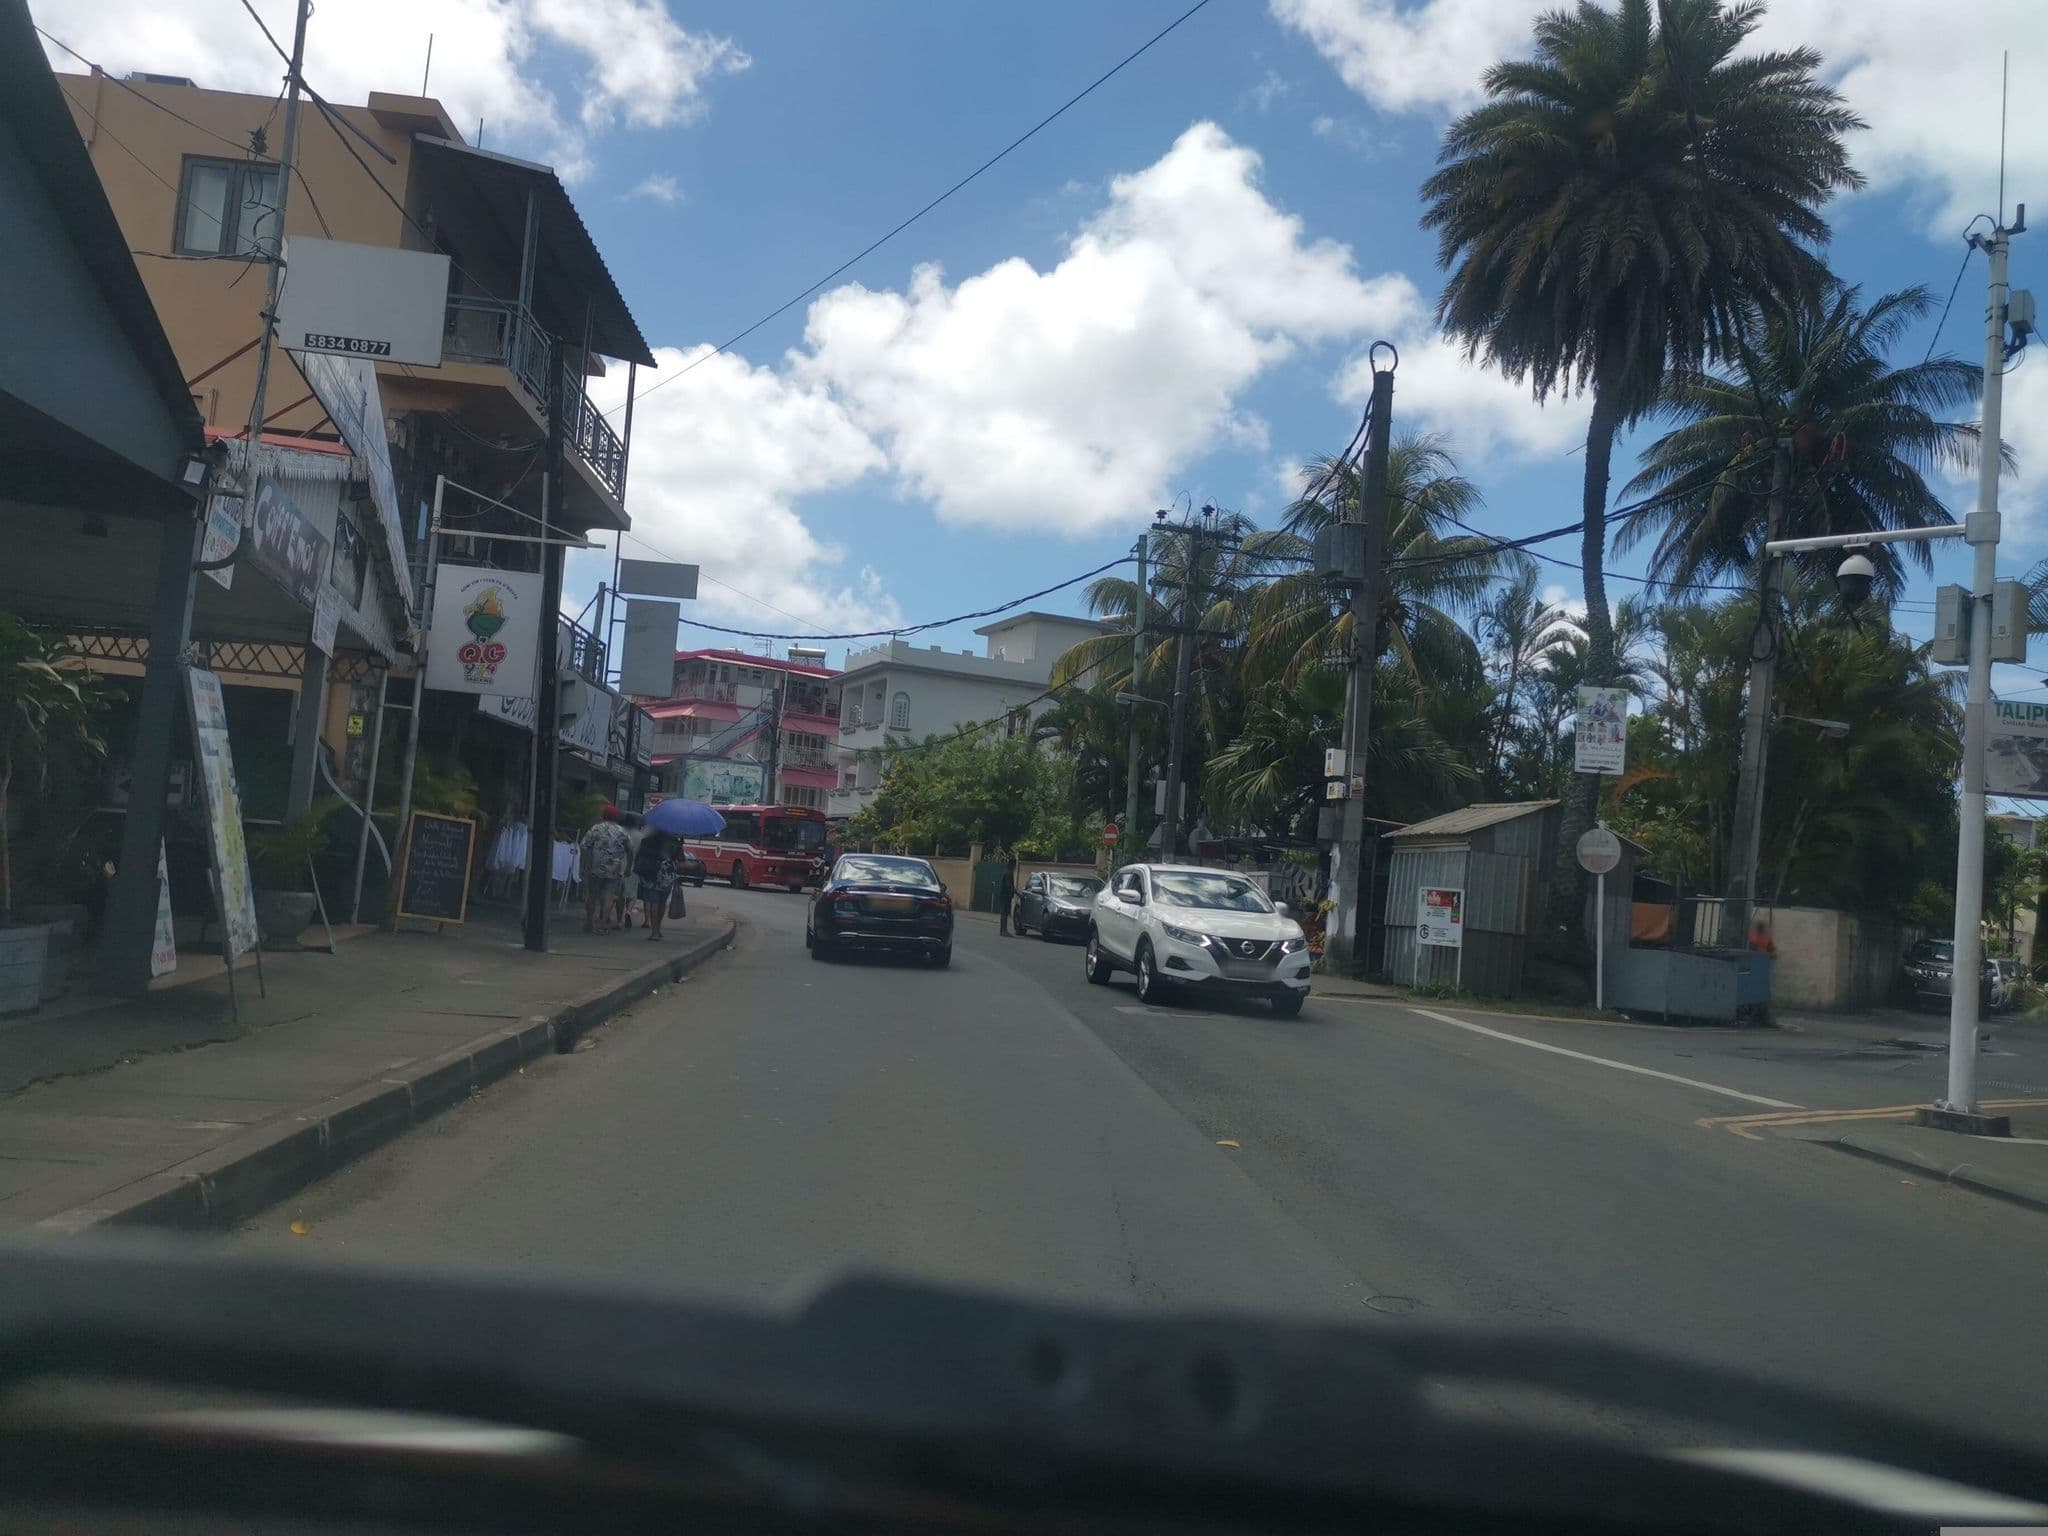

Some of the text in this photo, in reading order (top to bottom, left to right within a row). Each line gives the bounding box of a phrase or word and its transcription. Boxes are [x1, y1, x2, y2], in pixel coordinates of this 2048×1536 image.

[308, 335, 388, 354] 5834 0877
[1994, 702, 2048, 721] TALIP
